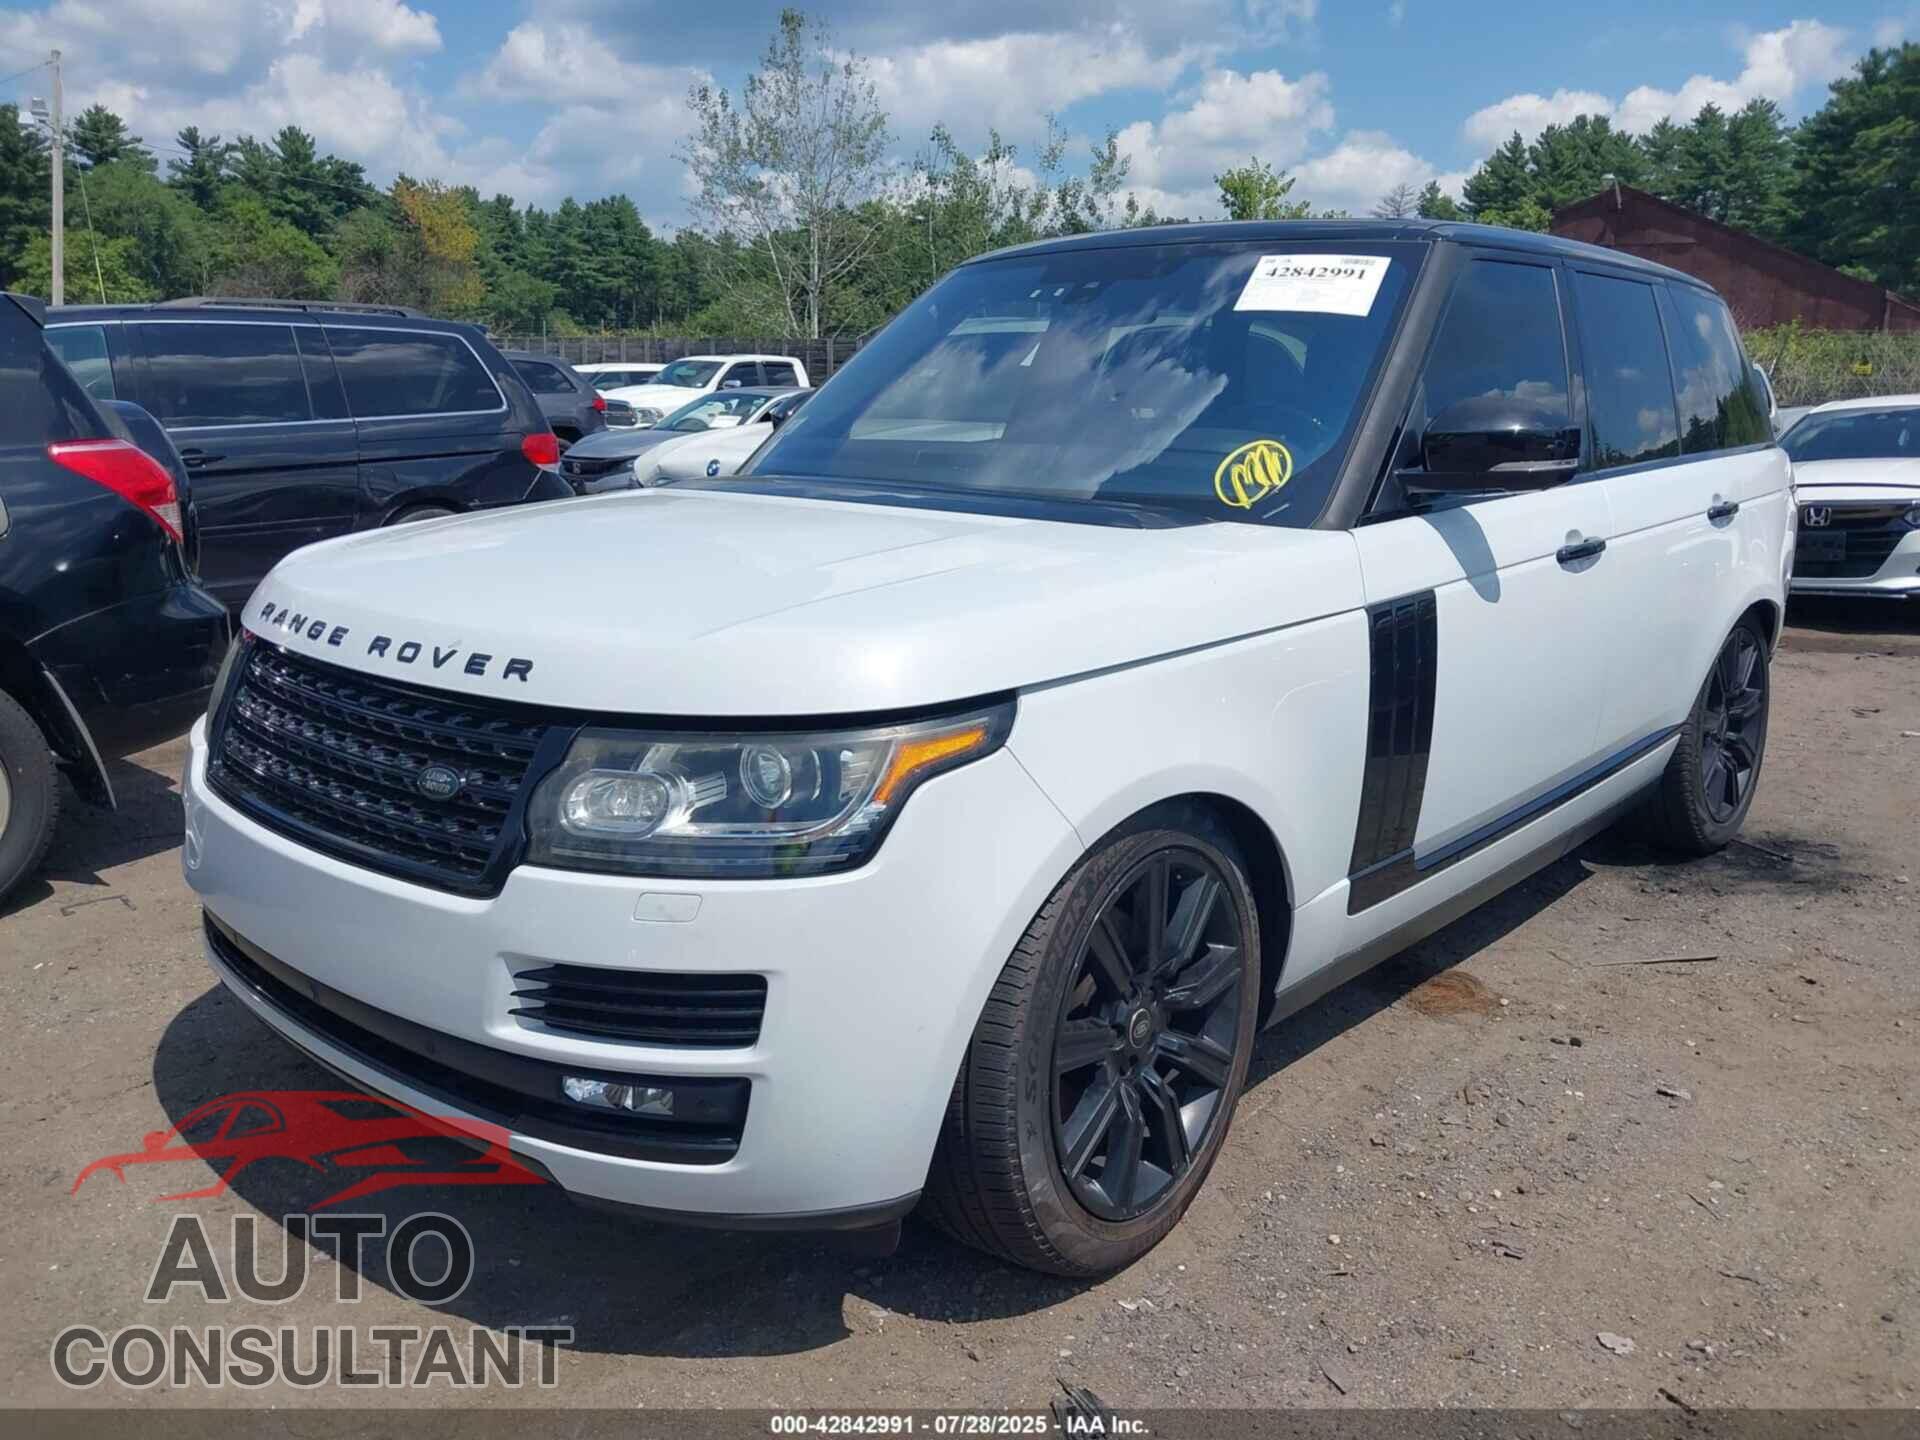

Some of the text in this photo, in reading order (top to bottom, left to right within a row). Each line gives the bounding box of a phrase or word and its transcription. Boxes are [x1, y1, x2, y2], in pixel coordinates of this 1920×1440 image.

[1265, 266, 1366, 280] 42842991
[260, 602, 534, 682] RANGE ROVER
